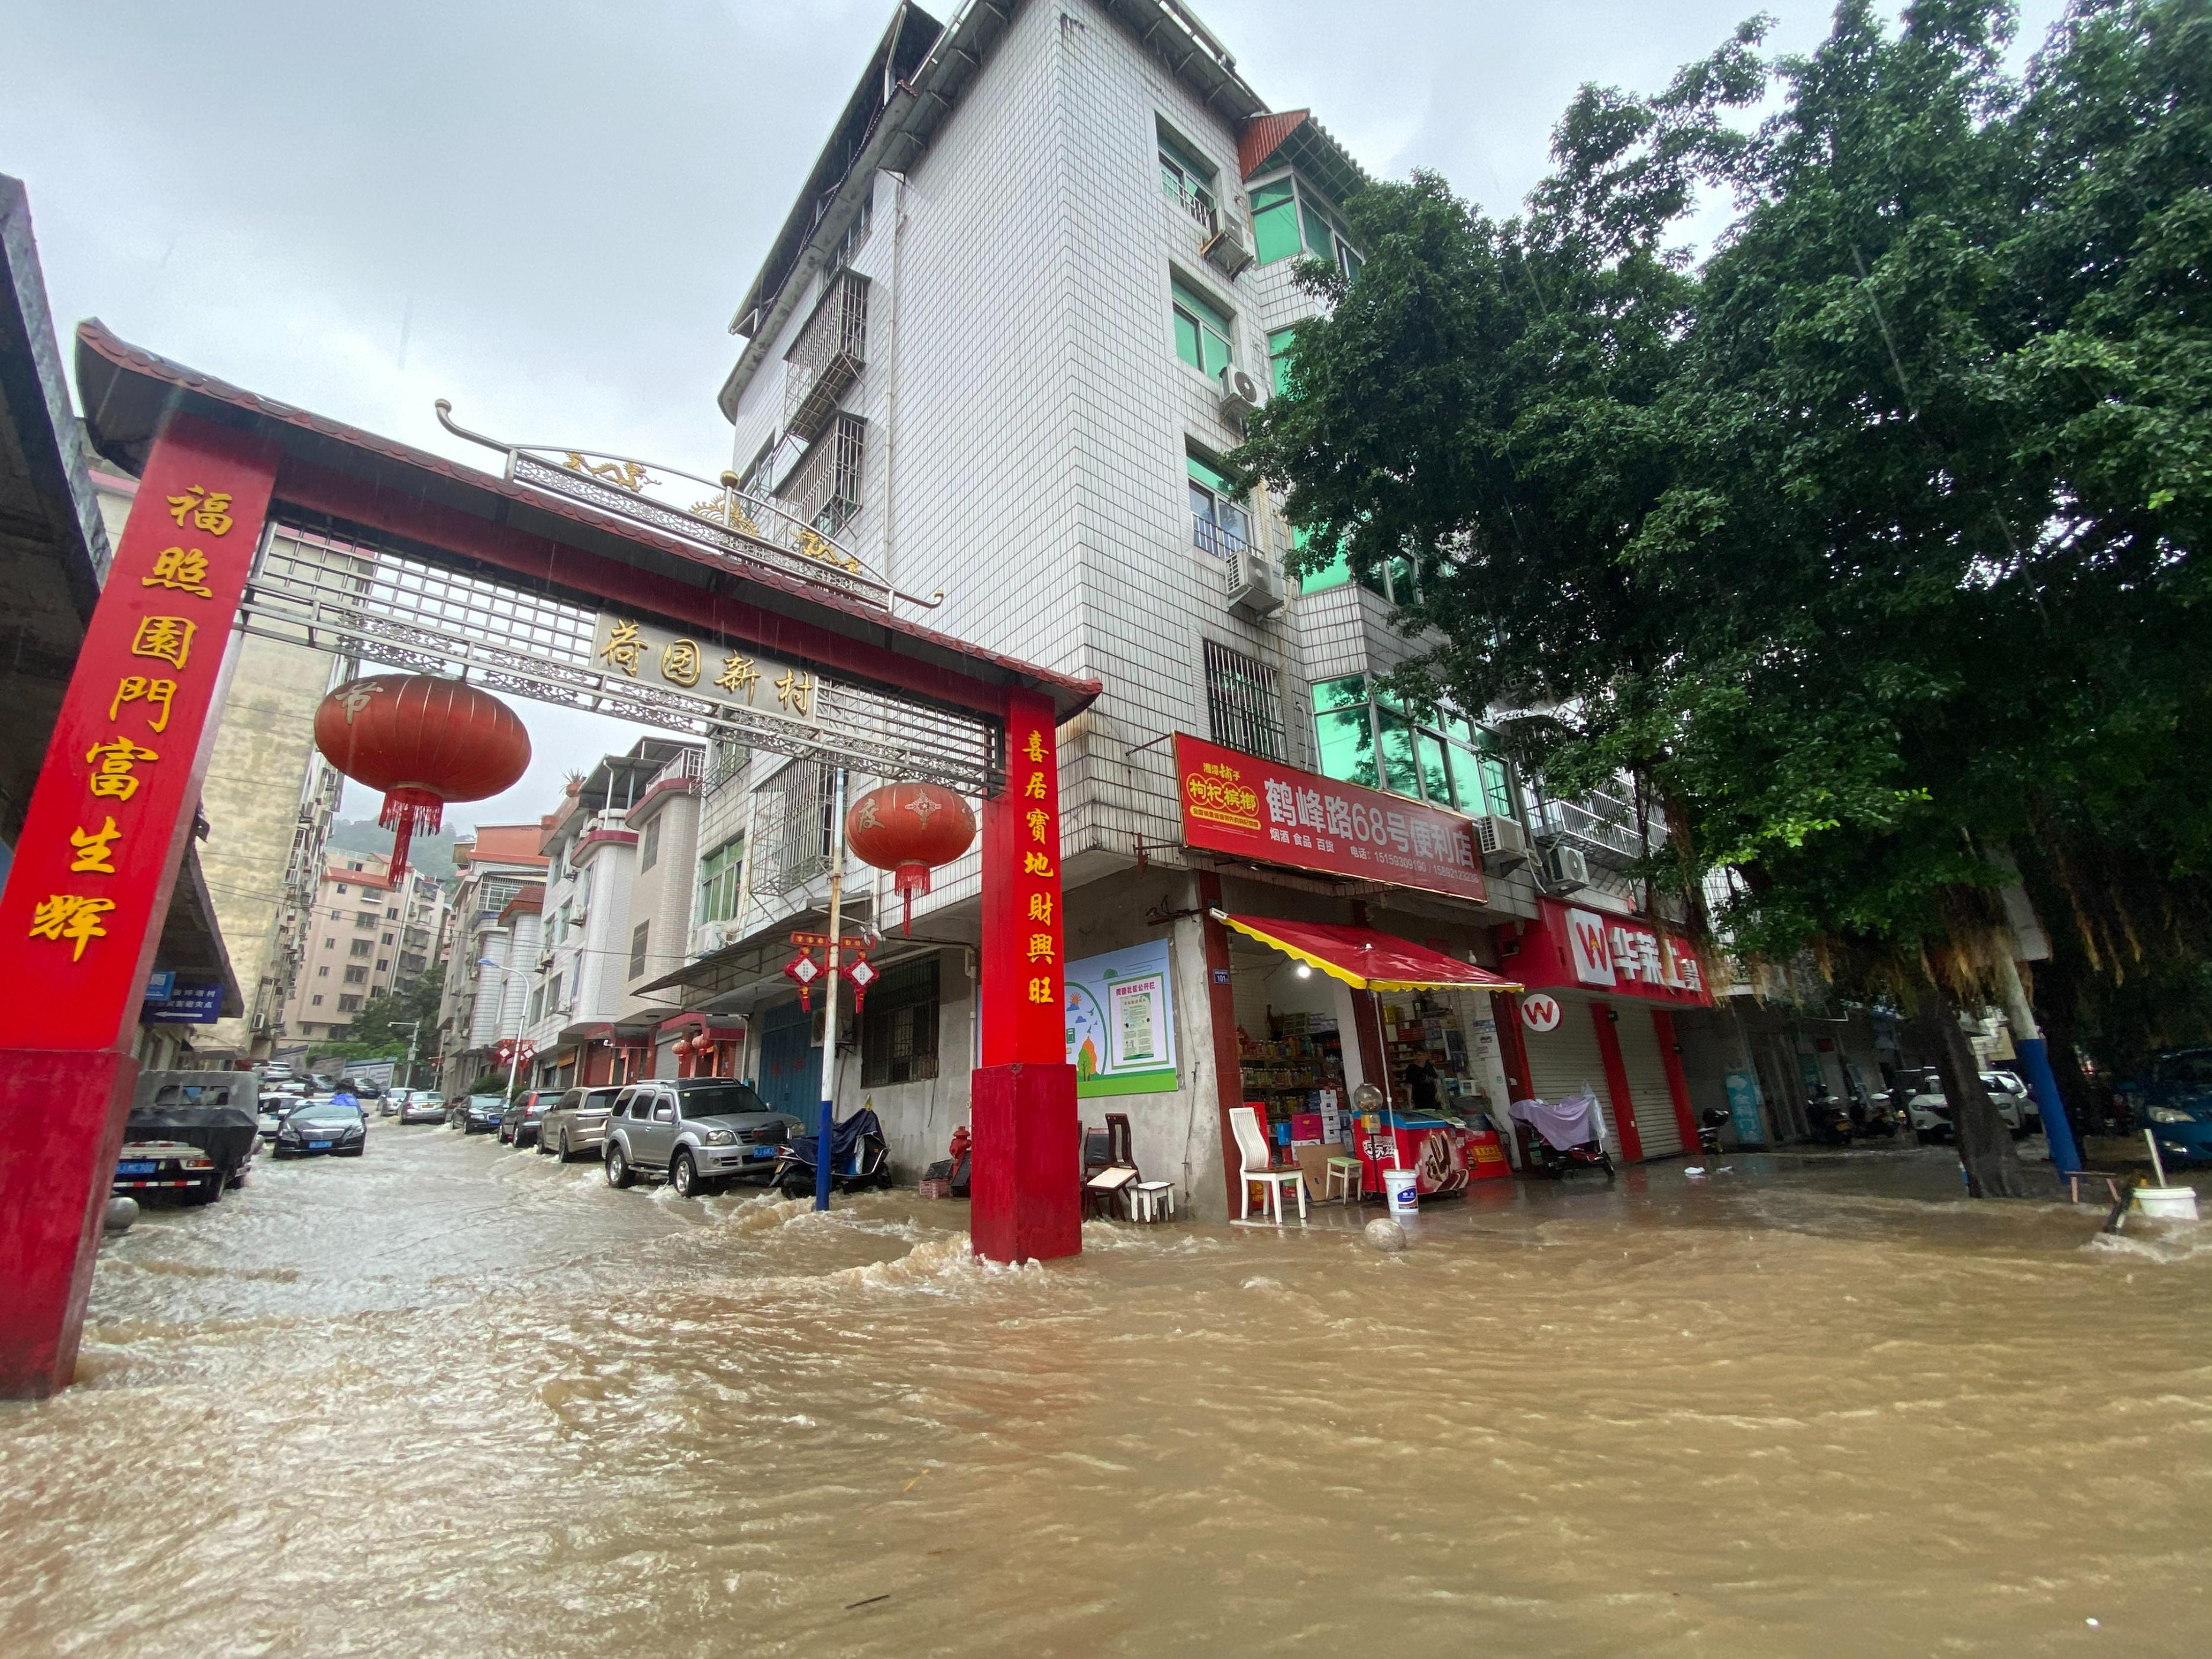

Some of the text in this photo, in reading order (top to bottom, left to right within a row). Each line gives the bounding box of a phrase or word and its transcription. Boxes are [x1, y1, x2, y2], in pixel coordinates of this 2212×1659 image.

[600, 618, 813, 716] 荷园新村
[1189, 779, 1257, 812] 枸杞槟榔
[1264, 777, 1475, 869] 鹤峰路68号便利店
[1270, 827, 1335, 853] 烟酒 食品 百货
[1022, 730, 1055, 1005] 喜居寶地財興旺
